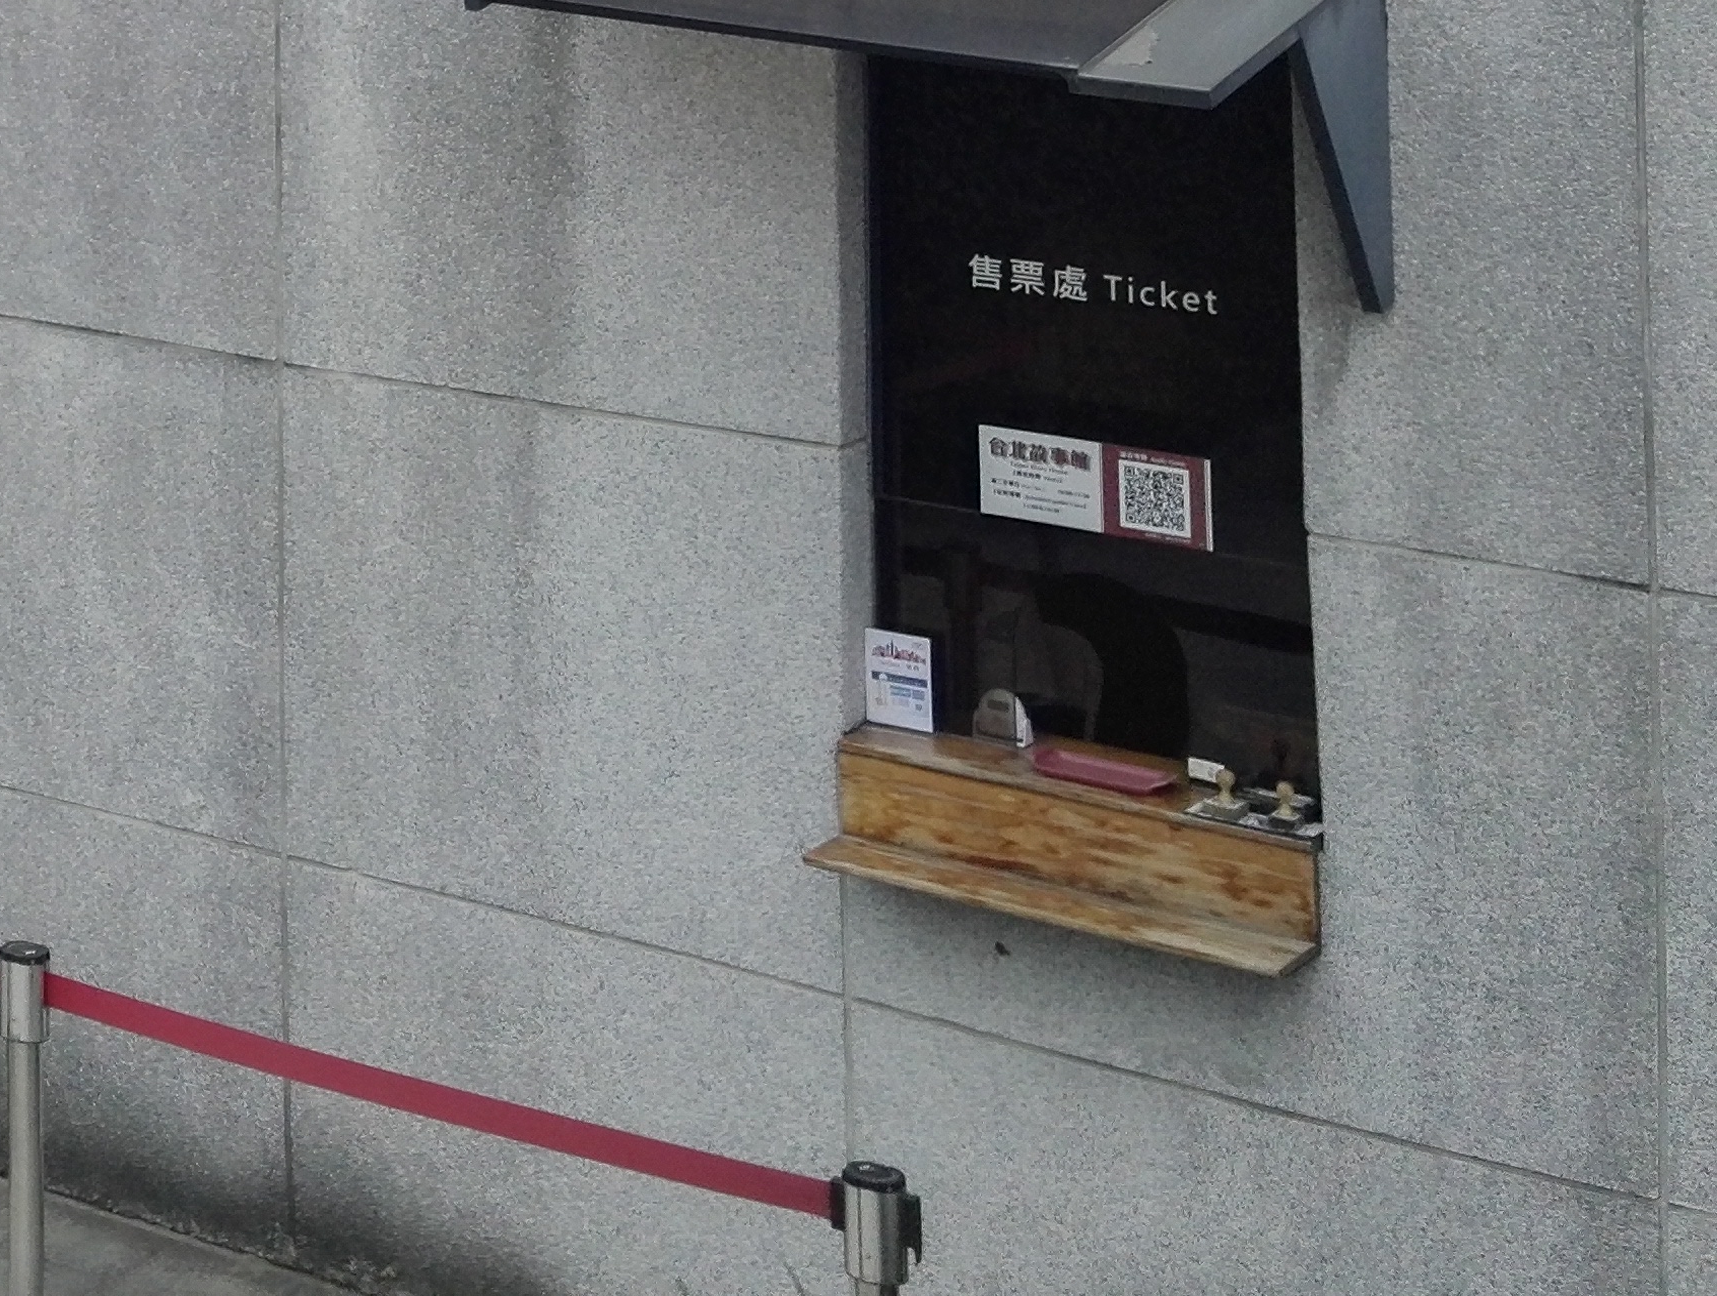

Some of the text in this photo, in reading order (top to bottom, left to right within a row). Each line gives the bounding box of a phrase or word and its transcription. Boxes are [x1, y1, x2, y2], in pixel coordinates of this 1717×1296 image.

[968, 253, 1218, 315] 售票處 Ticket
